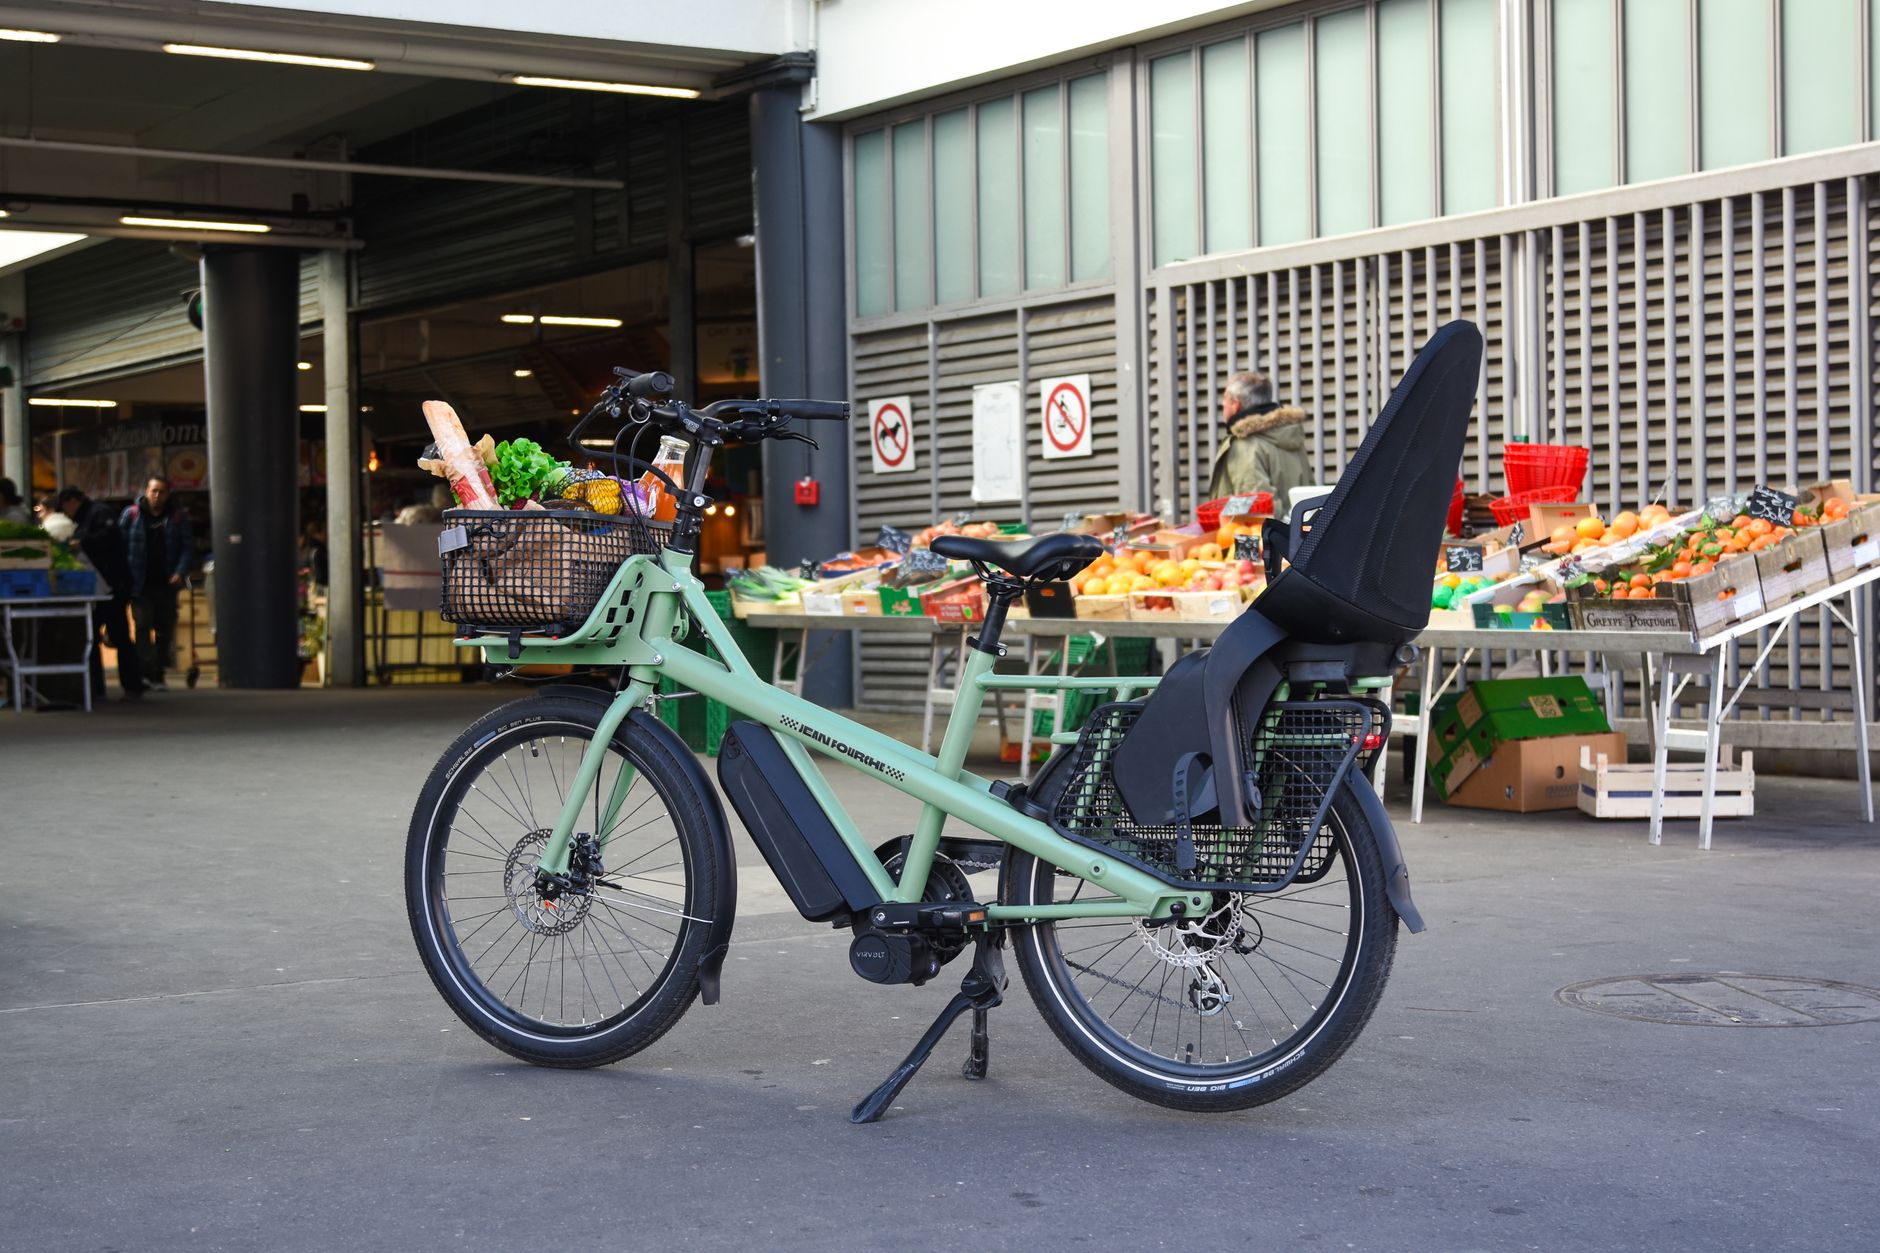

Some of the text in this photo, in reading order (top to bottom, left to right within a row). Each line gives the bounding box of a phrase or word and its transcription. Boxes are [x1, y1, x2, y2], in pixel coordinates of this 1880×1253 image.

[1625, 612, 1677, 628] PORTUGAL
[445, 747, 473, 779] SCHWALBE
[1262, 1049, 1306, 1079] SCHWALBE
[1209, 1083, 1227, 1092] BIG
